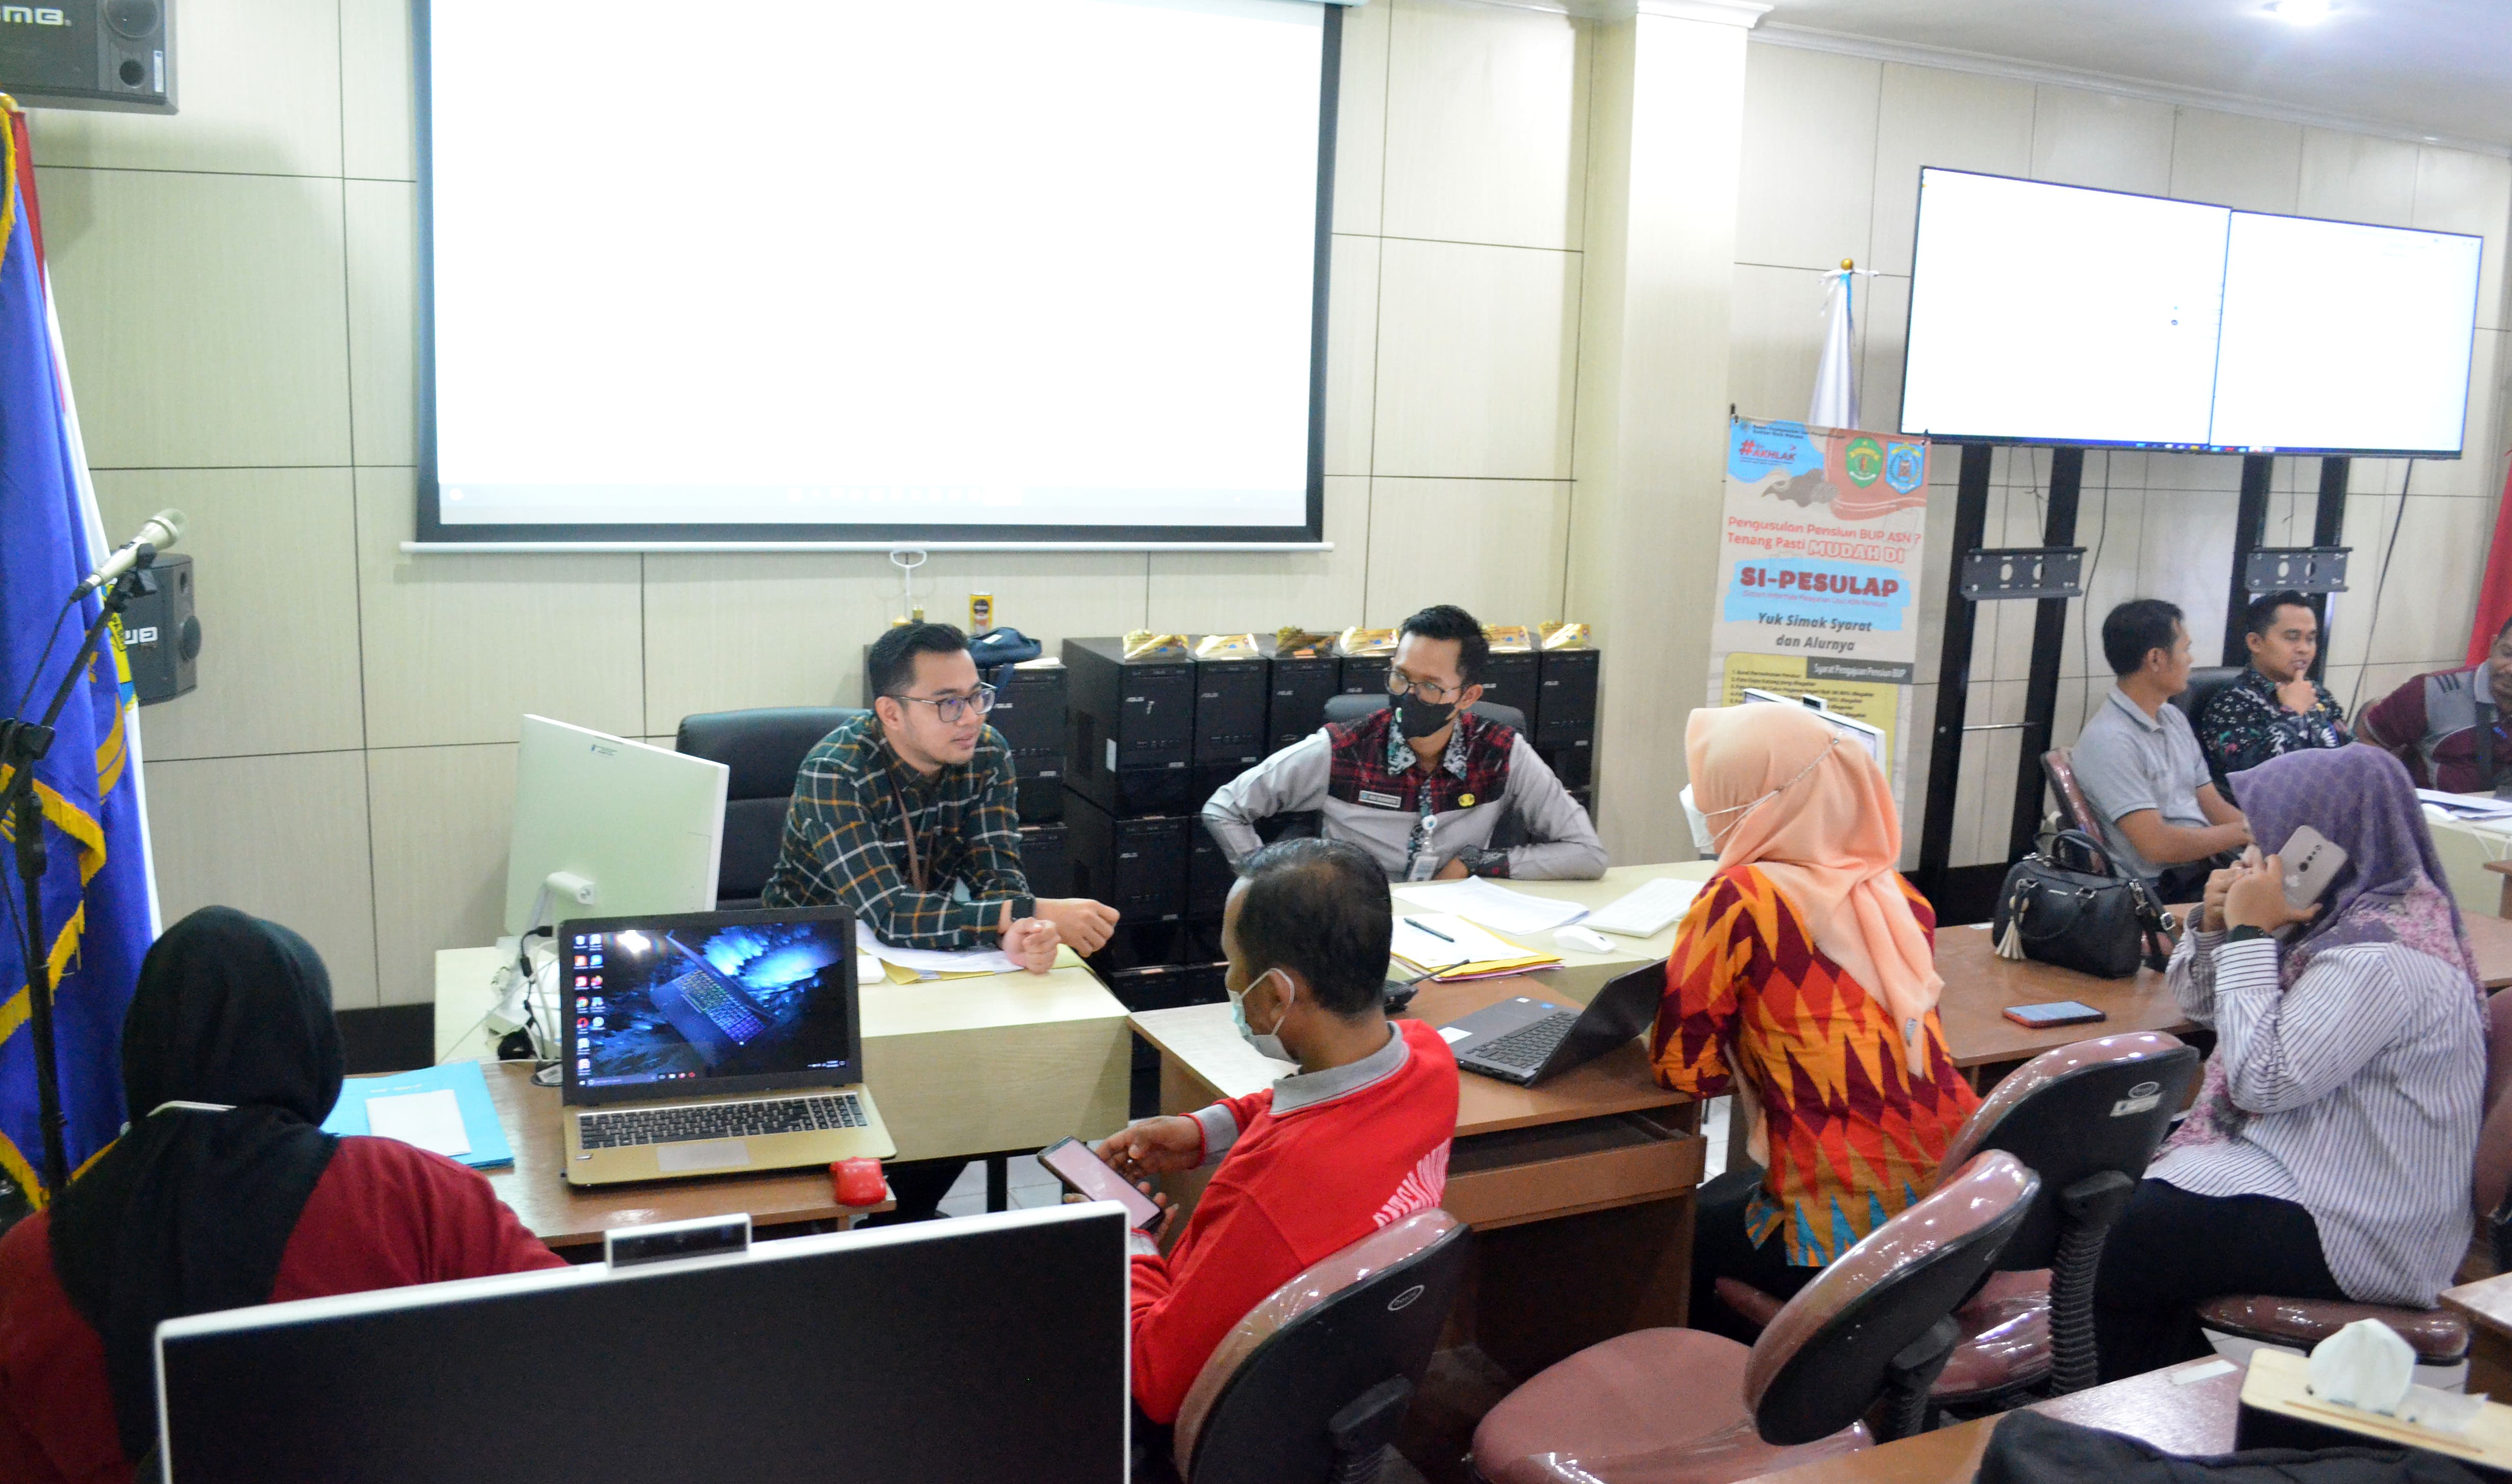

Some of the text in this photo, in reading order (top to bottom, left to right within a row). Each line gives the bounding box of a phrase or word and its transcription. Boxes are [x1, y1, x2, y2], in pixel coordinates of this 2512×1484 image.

[1728, 516, 1803, 533] Pengusulan
[1807, 524, 1856, 539] Pensiun
[1860, 529, 1883, 541] BUP
[1887, 532, 1911, 543] ASN
[1728, 533, 1905, 564] Tenang Pasti MUDAH DI
[1740, 566, 1899, 597] SI-PESULAP
[1759, 612, 1873, 633] Yuk Simak Syarat
[1775, 634, 1856, 654] dan Alurnya
